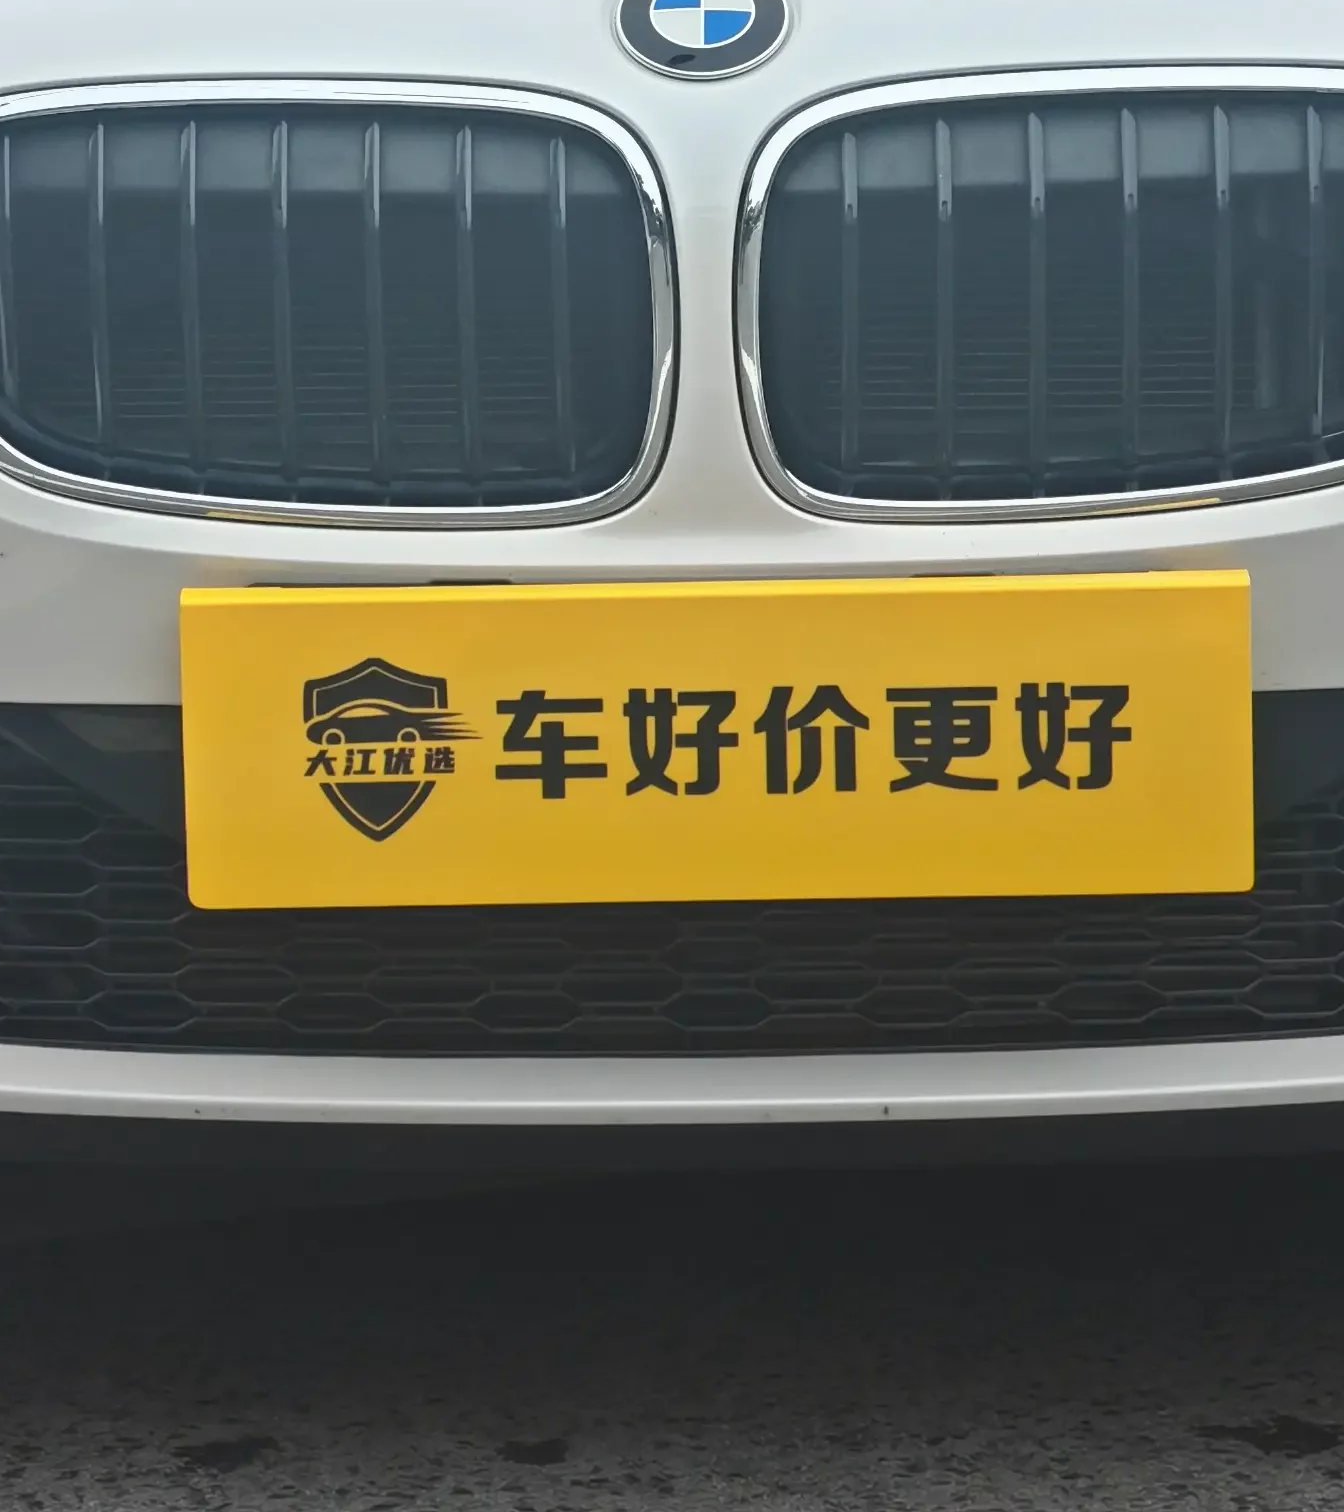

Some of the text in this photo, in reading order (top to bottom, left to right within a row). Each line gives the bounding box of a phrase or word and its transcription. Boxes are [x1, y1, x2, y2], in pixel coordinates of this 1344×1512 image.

[304, 746, 455, 777] 大江优选
[495, 682, 1132, 799] 车好价更好
